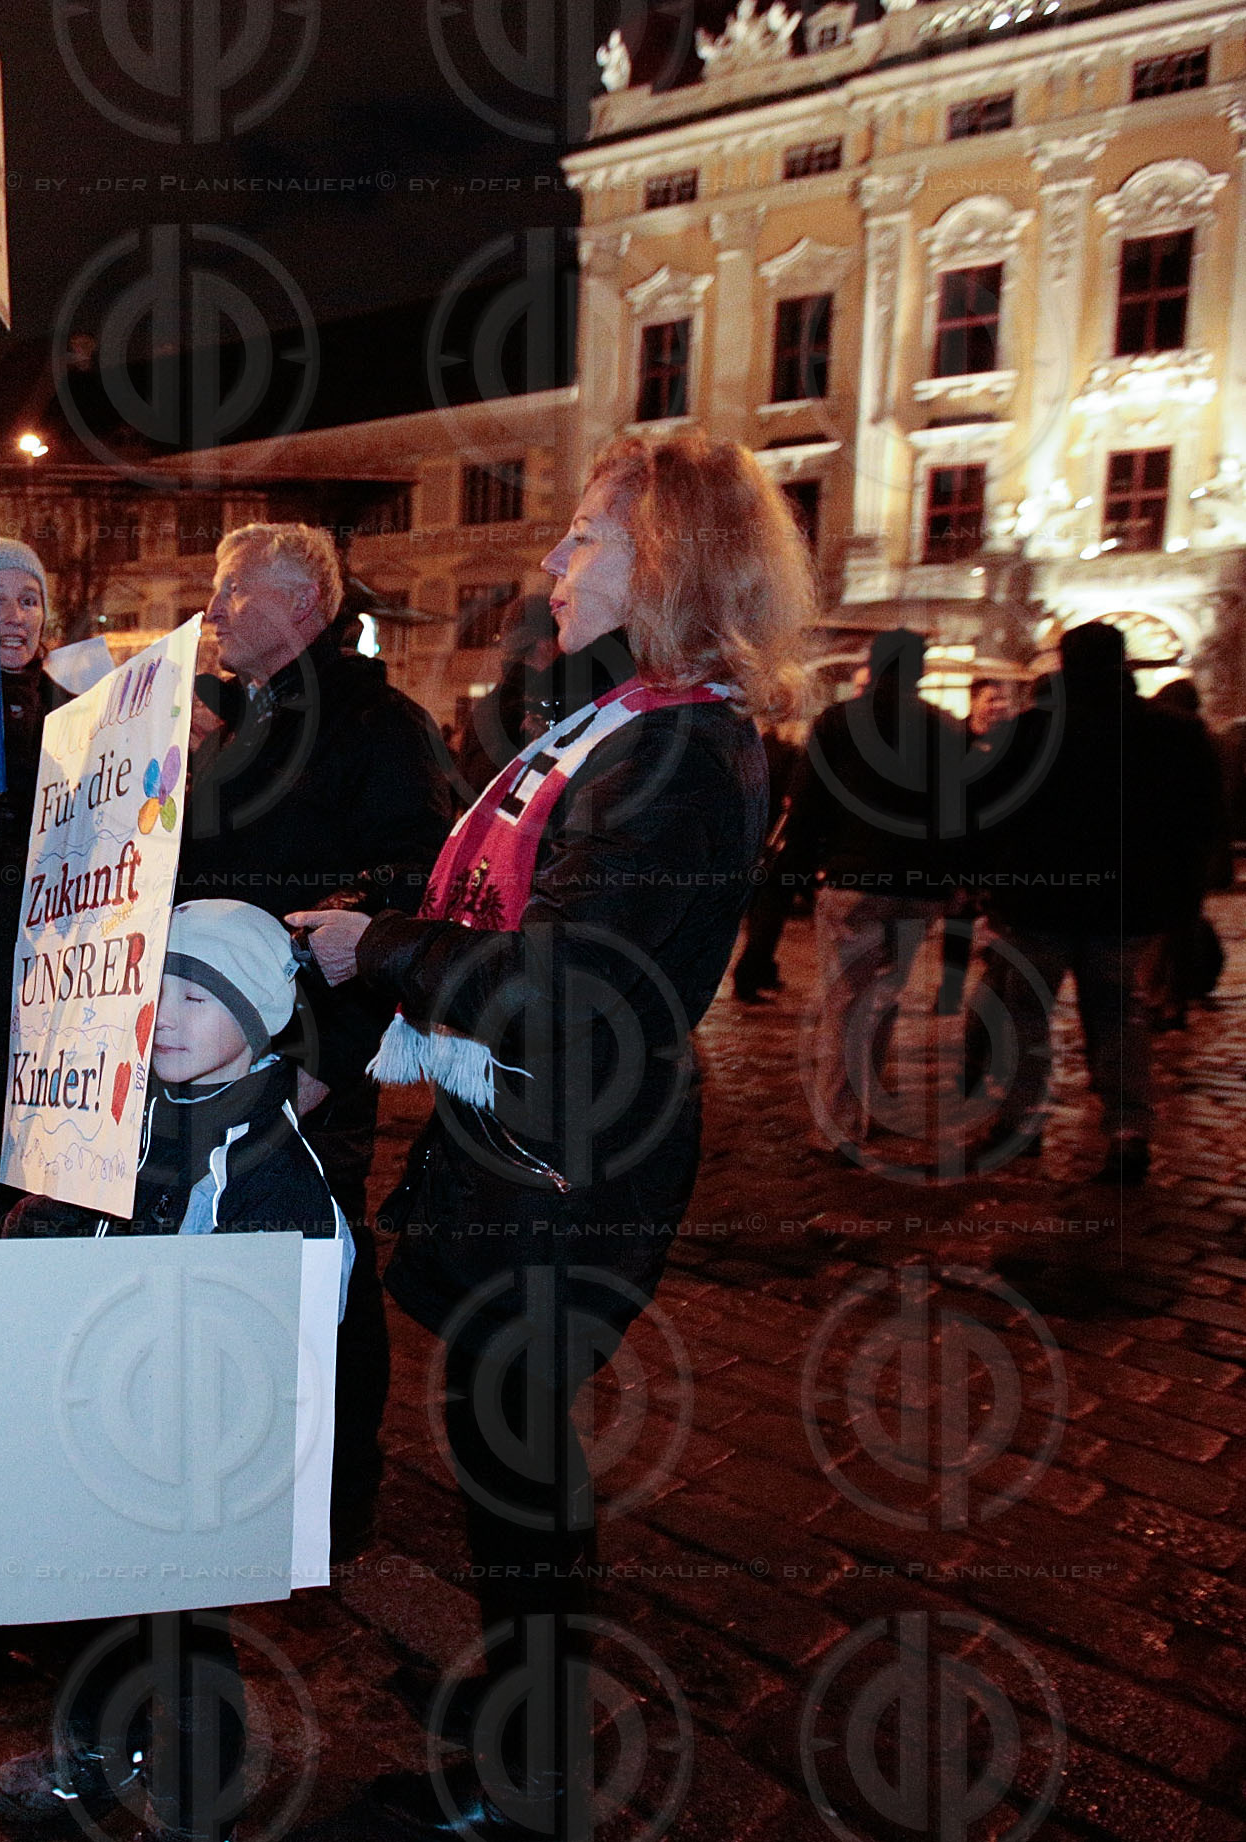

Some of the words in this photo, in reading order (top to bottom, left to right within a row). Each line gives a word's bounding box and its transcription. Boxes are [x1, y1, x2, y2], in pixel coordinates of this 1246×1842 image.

[37, 779, 82, 835] Für
[87, 749, 133, 810] die
[25, 839, 142, 928] Zukunft
[21, 931, 146, 1007] UNSRER
[10, 1049, 106, 1113] Kinder!
